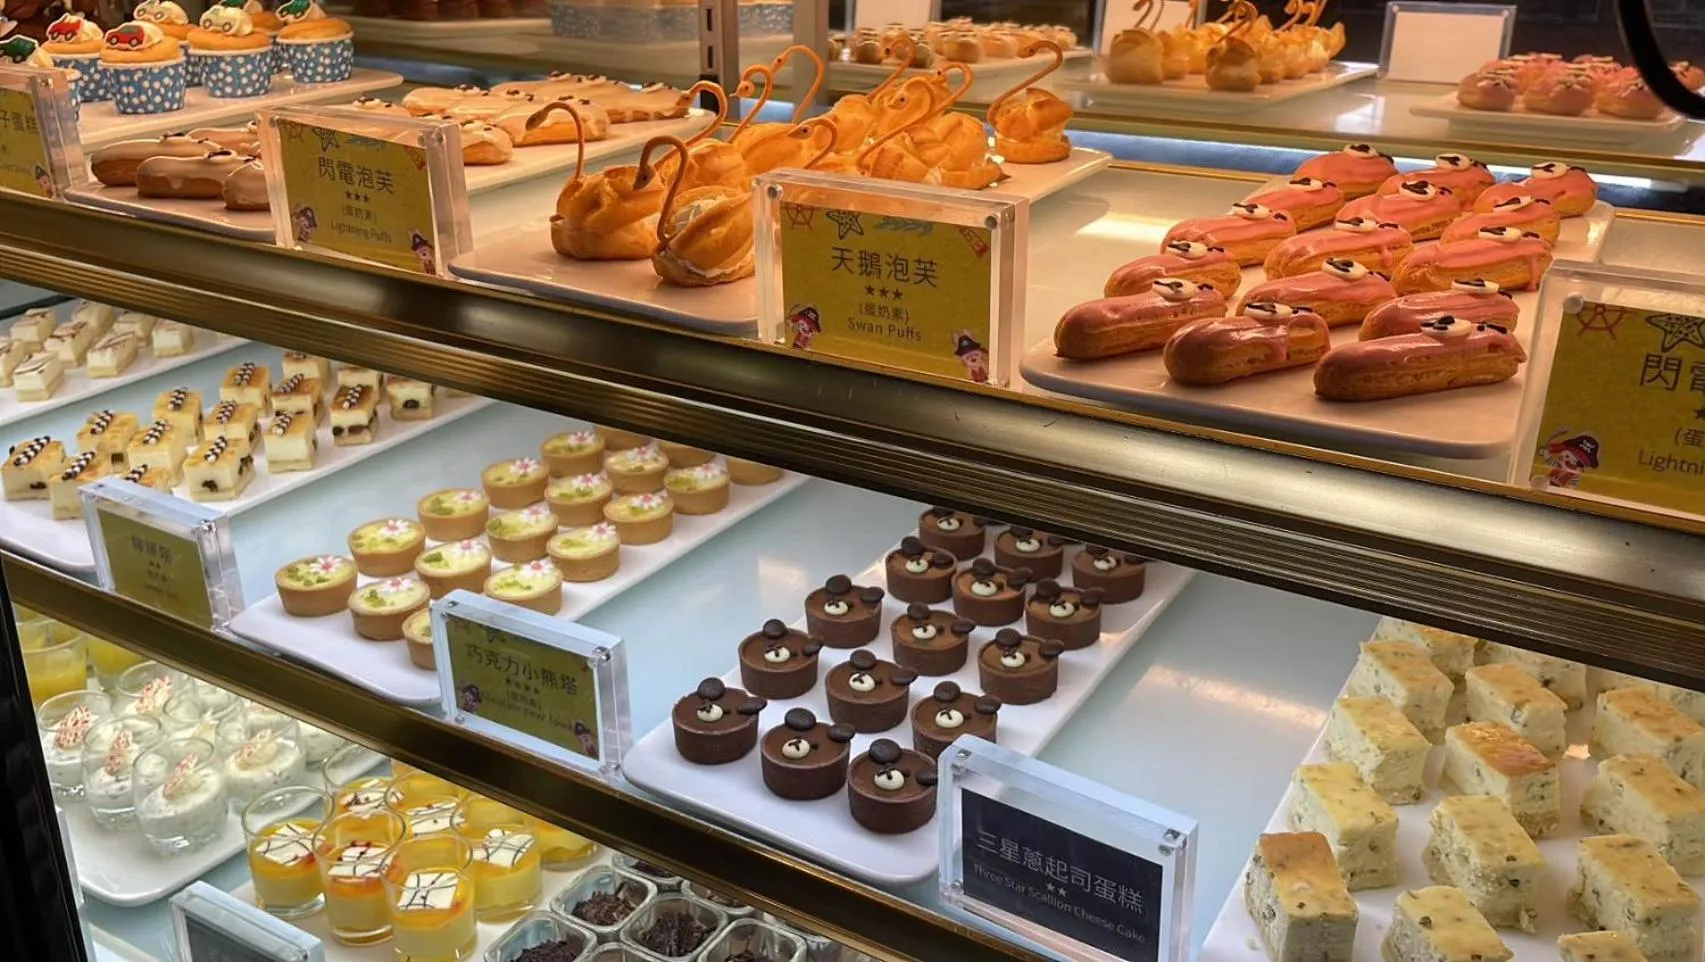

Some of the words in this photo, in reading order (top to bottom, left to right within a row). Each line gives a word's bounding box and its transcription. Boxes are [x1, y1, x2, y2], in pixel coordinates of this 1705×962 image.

[317, 156, 395, 195] 閃電泡芙
[831, 246, 939, 288] 天鵝泡芙
[848, 317, 883, 335] Swan
[888, 325, 922, 342] Puffs
[858, 302, 910, 324] (蛋奶素)
[467, 644, 577, 696] 巧克力小熊塔
[976, 828, 1144, 915] 三星蔥起司蛋糕
[1028, 886, 1072, 913] Scallion
[1073, 906, 1115, 932] Cheese
[1116, 924, 1146, 943] Cake
